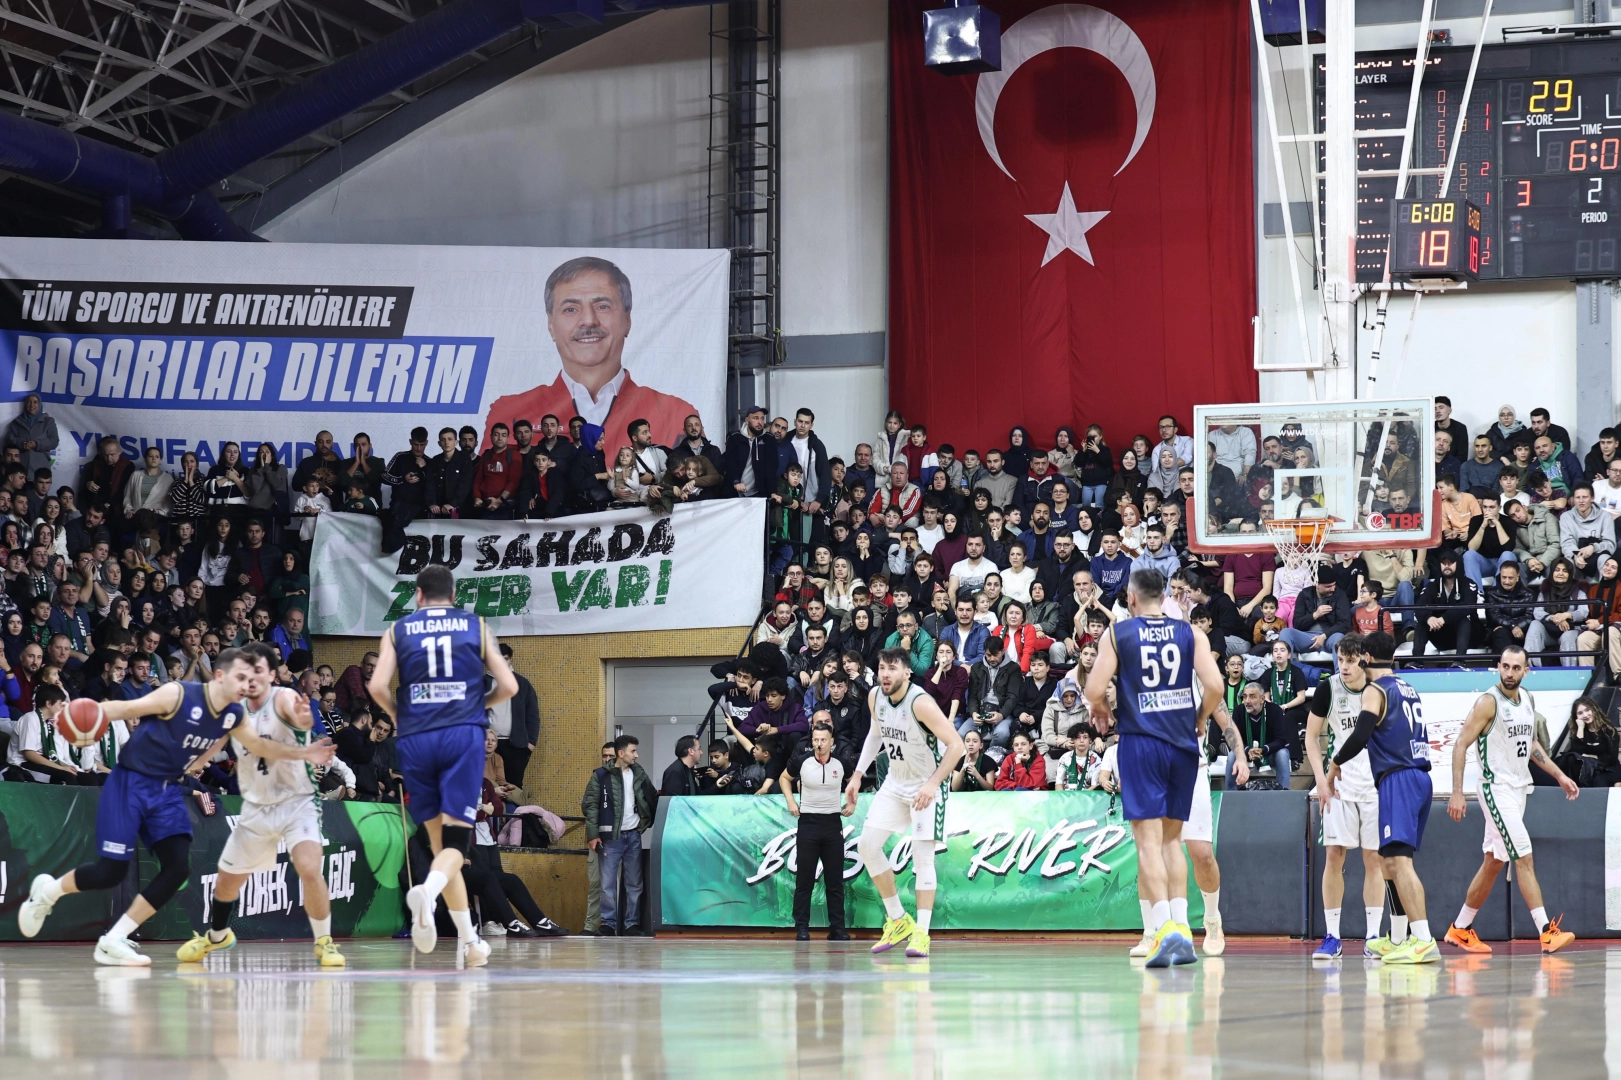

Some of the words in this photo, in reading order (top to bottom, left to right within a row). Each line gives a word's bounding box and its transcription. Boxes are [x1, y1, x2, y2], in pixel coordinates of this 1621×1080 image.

[1354, 74, 1388, 84] LAYER
[1529, 79, 1573, 113] 29
[1437, 119, 1446, 133] 5
[1526, 113, 1554, 127] SCORE
[1580, 123, 1603, 135] TIME
[1437, 134, 1446, 148] 6
[1438, 149, 1446, 162] 7
[1480, 161, 1491, 176] 2
[1516, 180, 1532, 207] 3
[1587, 177, 1603, 204] 2
[1411, 203, 1455, 224] 6:08
[1581, 211, 1608, 224] PERIOD
[1419, 230, 1450, 267] 18
[1481, 251, 1491, 265] 2
[21, 283, 73, 322] TÜM
[75, 291, 178, 324] SPORCU
[181, 293, 213, 325] VE
[214, 288, 397, 328] ANTRENÖRLERE
[11, 335, 273, 406] BAŞARILAR
[1387, 513, 1423, 530] TBF
[396, 534, 466, 575] BU
[473, 517, 676, 572] SAHADA
[383, 574, 532, 622] ZFER
[551, 559, 673, 612] VAR!
[404, 618, 469, 636] TOLGAHAN
[1138, 625, 1175, 642] MESUT
[421, 635, 453, 678] 11
[1140, 643, 1181, 688] 59
[1160, 690, 1191, 699] PHARMACY
[1161, 697, 1192, 706] NUTRITION
[881, 726, 908, 743] SAKARYA
[1507, 724, 1533, 738] SAKARY
[889, 743, 905, 760] 24
[1516, 740, 1528, 757] 23
[257, 756, 269, 776] 4
[328, 845, 357, 903] GÜÇ
